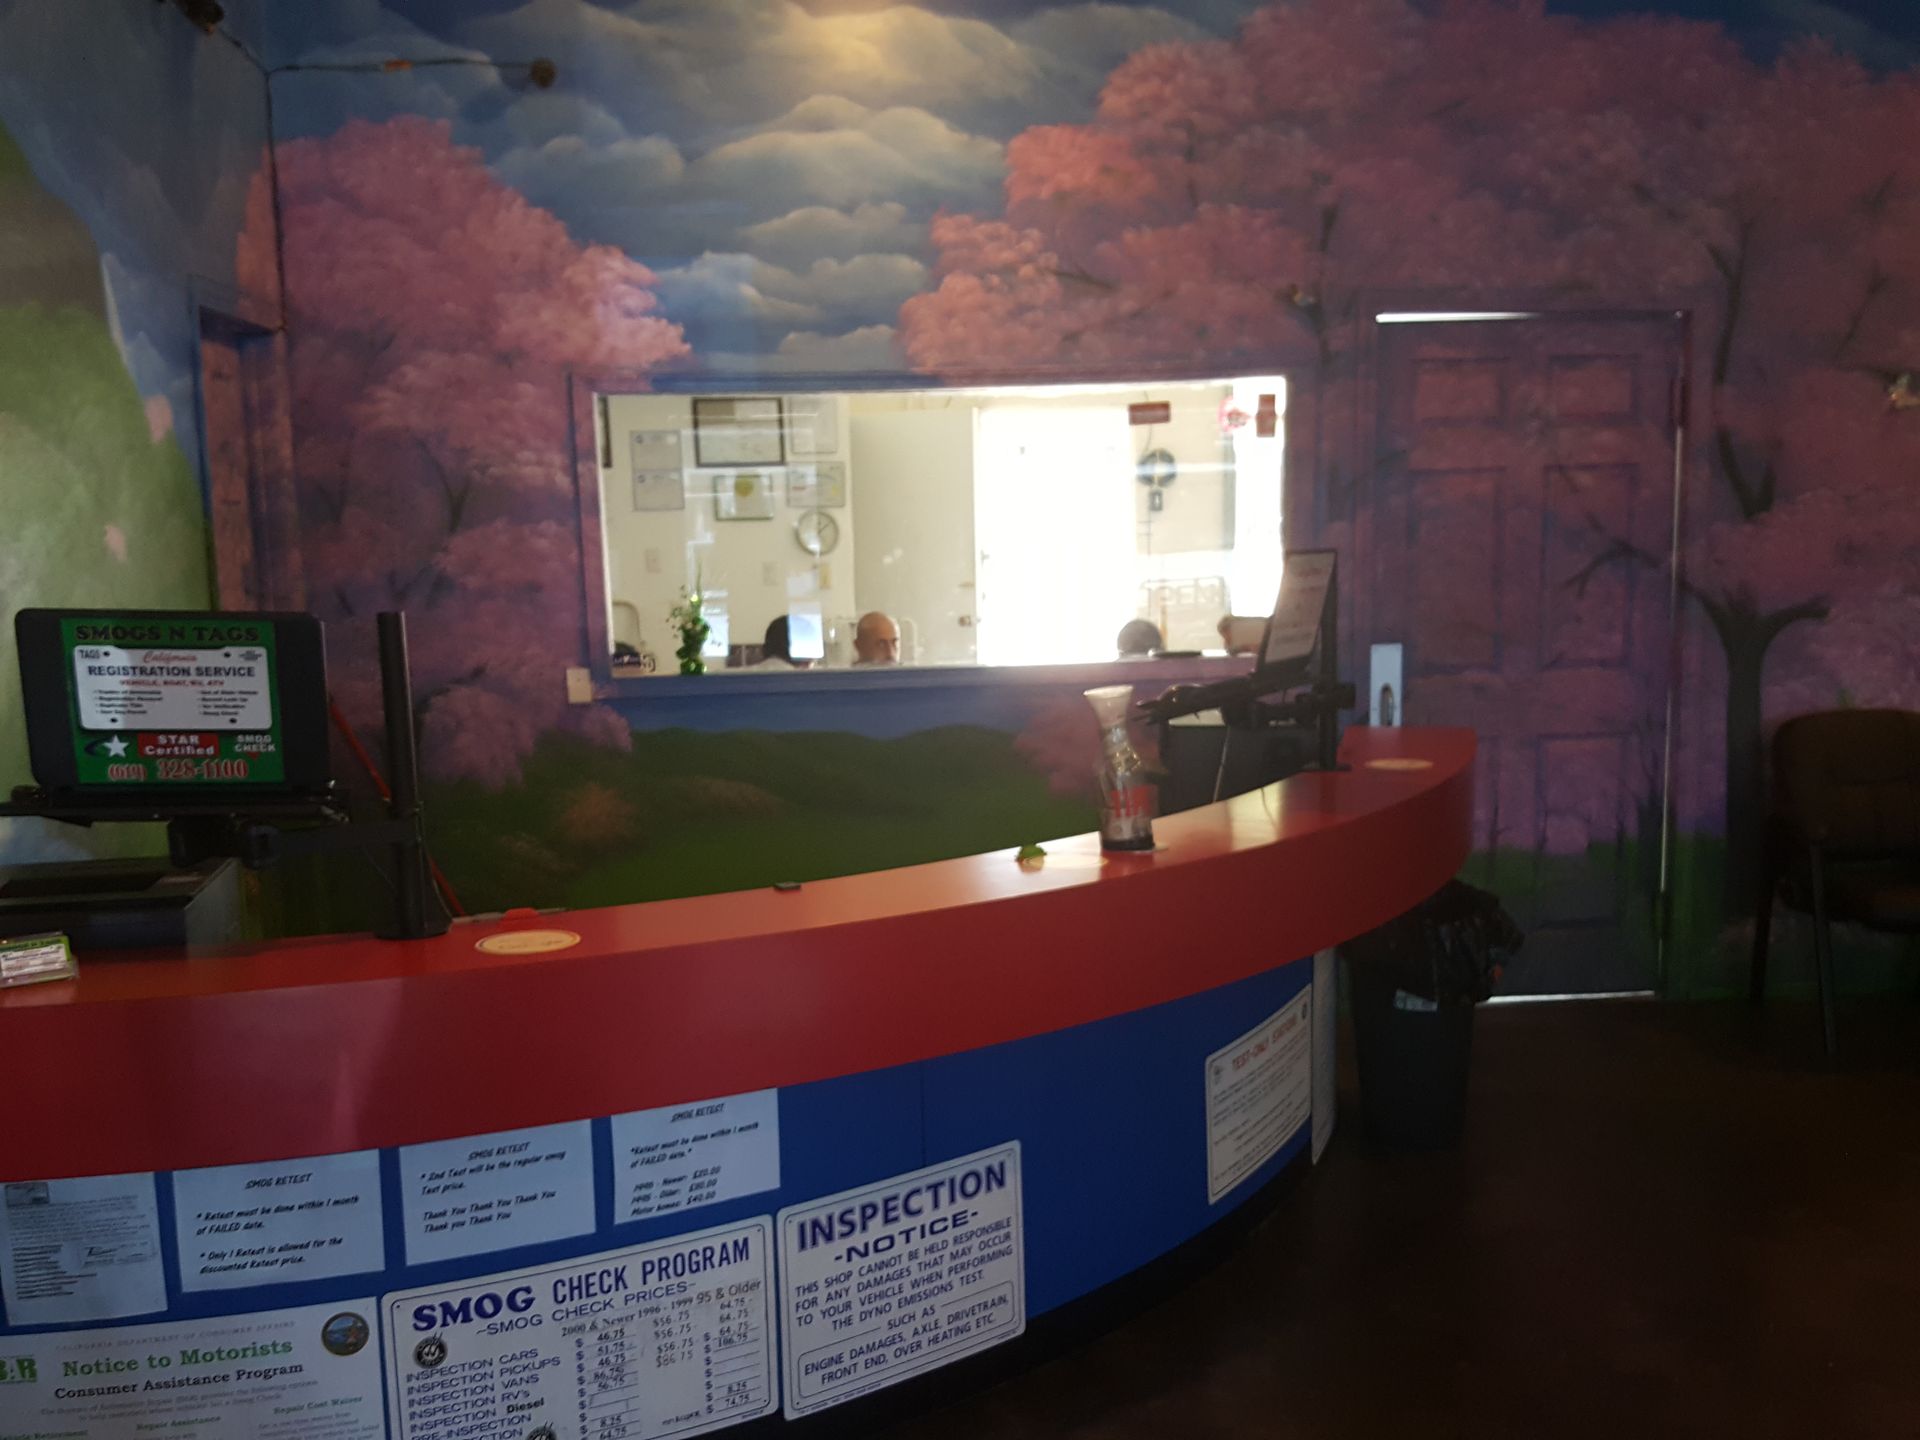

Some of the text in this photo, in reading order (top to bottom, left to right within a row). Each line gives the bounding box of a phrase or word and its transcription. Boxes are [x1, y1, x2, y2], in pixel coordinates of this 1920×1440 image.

[76, 625, 259, 641] SMOGS N TAGS
[88, 665, 255, 677] REGISTRATION SERVICE
[144, 745, 214, 756] Certified
[157, 734, 199, 745] STAR
[234, 743, 276, 753] CHECK
[236, 734, 272, 744] SMOG
[156, 759, 249, 779] 328-1100
[495, 1142, 530, 1156] RETEST
[640, 1154, 667, 1166] FAILED
[448, 1168, 468, 1178] Test
[469, 1165, 484, 1175] will
[485, 1162, 495, 1171] be
[498, 1159, 511, 1169] the
[513, 1156, 543, 1168] regular
[245, 1172, 314, 1189] SMOG RETEST
[422, 1186, 440, 1195] Test
[204, 1211, 234, 1222] Retest
[236, 1208, 258, 1218] must
[260, 1206, 271, 1215] be
[274, 1203, 295, 1214] done
[298, 1200, 323, 1210] within
[332, 1195, 359, 1205] month
[423, 1190, 557, 1221] Thank You Thank You Thank You
[798, 1161, 1006, 1252] INSPECTION
[196, 1226, 207, 1236] of
[208, 1222, 240, 1235] FAILED
[424, 1212, 512, 1233] Thank you Thank You
[834, 1209, 979, 1263] -NOTICE-
[208, 1237, 343, 1261] Only Retest is allowed for the
[795, 1217, 1012, 1297] THIS SHOP CANNOT BE HELD RESPONSIBLE
[200, 1262, 248, 1274] discounted
[250, 1259, 279, 1269] Retest
[795, 1231, 1012, 1312] FOR ANY DAMAGES THAT MAY OCCUR
[412, 1285, 535, 1332] SMOG
[552, 1265, 628, 1304] CHECK
[642, 1236, 750, 1285] PROGRAM
[697, 1292, 713, 1305] 95
[715, 1288, 725, 1301] &
[728, 1279, 761, 1295] Older
[796, 1246, 1013, 1327] TO YOUR VEHICLE WHEN PERFORMING
[552, 1298, 615, 1322] CHECK
[637, 1305, 661, 1319] 1996
[832, 1314, 853, 1331] THE
[859, 1303, 892, 1322] DYNO
[897, 1283, 953, 1308] EMISSIONS
[887, 1305, 936, 1330] SUCH AS
[602, 1313, 635, 1329] Newer
[62, 1340, 293, 1377] Notice to Motorists
[406, 1349, 539, 1383] INSPECTION CARS
[804, 1352, 845, 1376] ENGINE
[850, 1333, 905, 1359] DAMAGES,
[821, 1322, 972, 1385] FRONT END, OVER HEATING
[55, 1363, 304, 1399] Consumer Assistance Program
[407, 1356, 561, 1395] INSPECTION PICKUPS
[408, 1373, 540, 1408] INSPECTION VANS
[409, 1389, 530, 1421] INSPECTION RV's
[410, 1398, 544, 1433] INSPECTION Diesel
